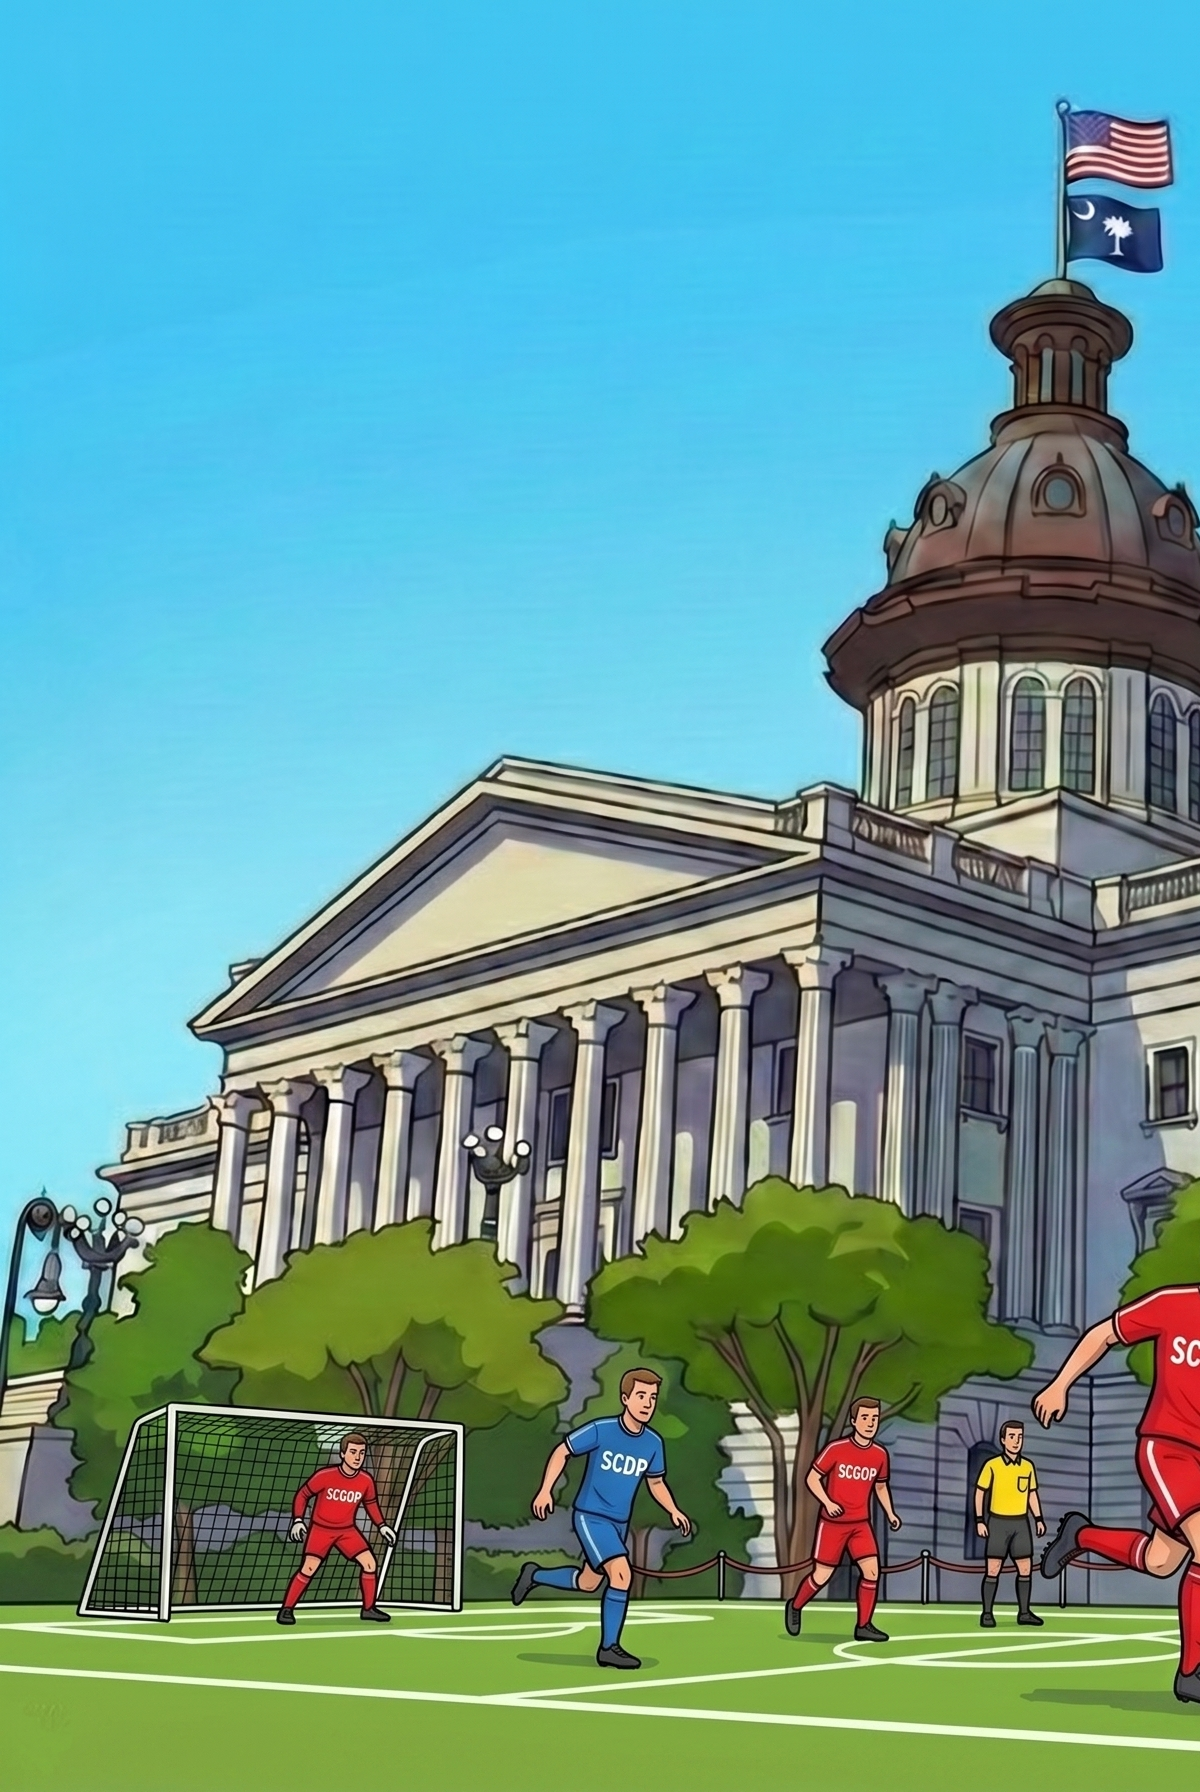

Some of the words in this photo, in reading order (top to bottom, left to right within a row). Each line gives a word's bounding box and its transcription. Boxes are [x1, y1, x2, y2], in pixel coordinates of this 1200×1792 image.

[600, 1450, 648, 1477] SCDP
[838, 1463, 877, 1481] SCGOP
[326, 1488, 362, 1503] SCGOP
